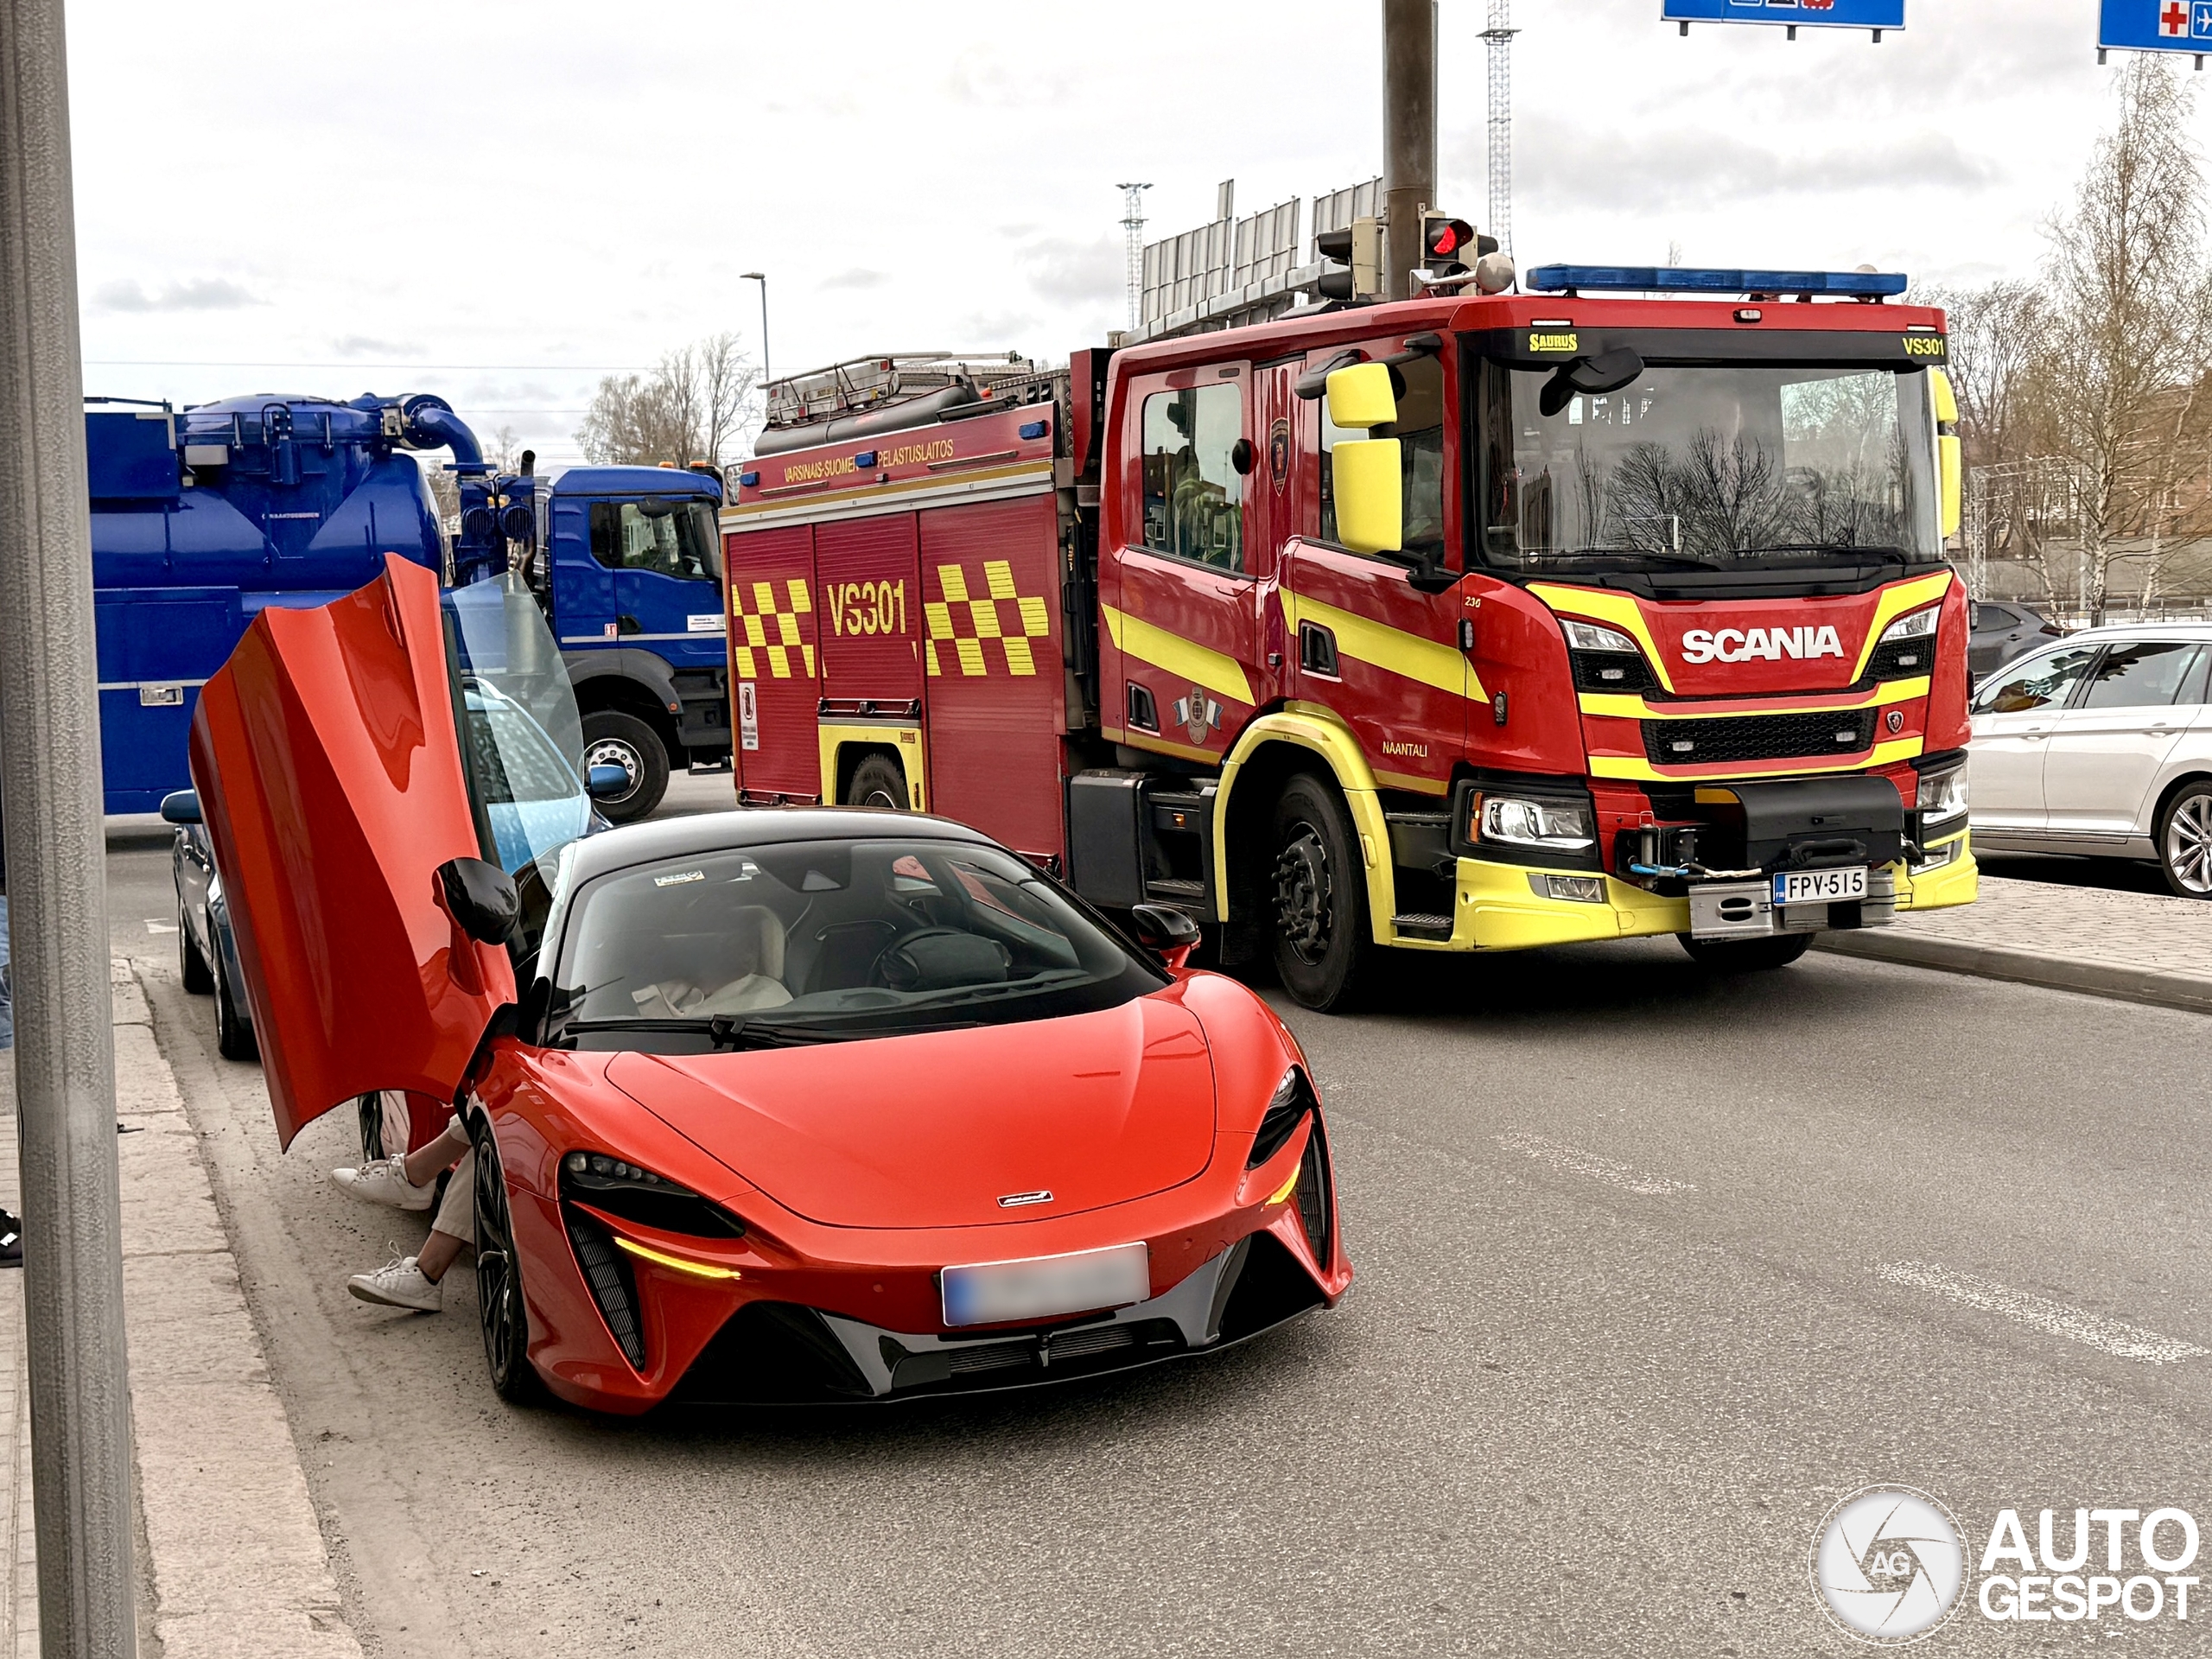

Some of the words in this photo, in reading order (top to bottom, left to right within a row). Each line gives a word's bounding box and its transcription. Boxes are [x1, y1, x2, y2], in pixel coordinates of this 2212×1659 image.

[1529, 334, 1578, 351] SAURUS
[1902, 338, 1944, 356] VS301
[877, 439, 954, 468] PELASTUSLAITOS
[827, 579, 906, 636] VS301
[1681, 626, 1844, 664] SCANIA
[1382, 741, 1427, 758] NAANTALI
